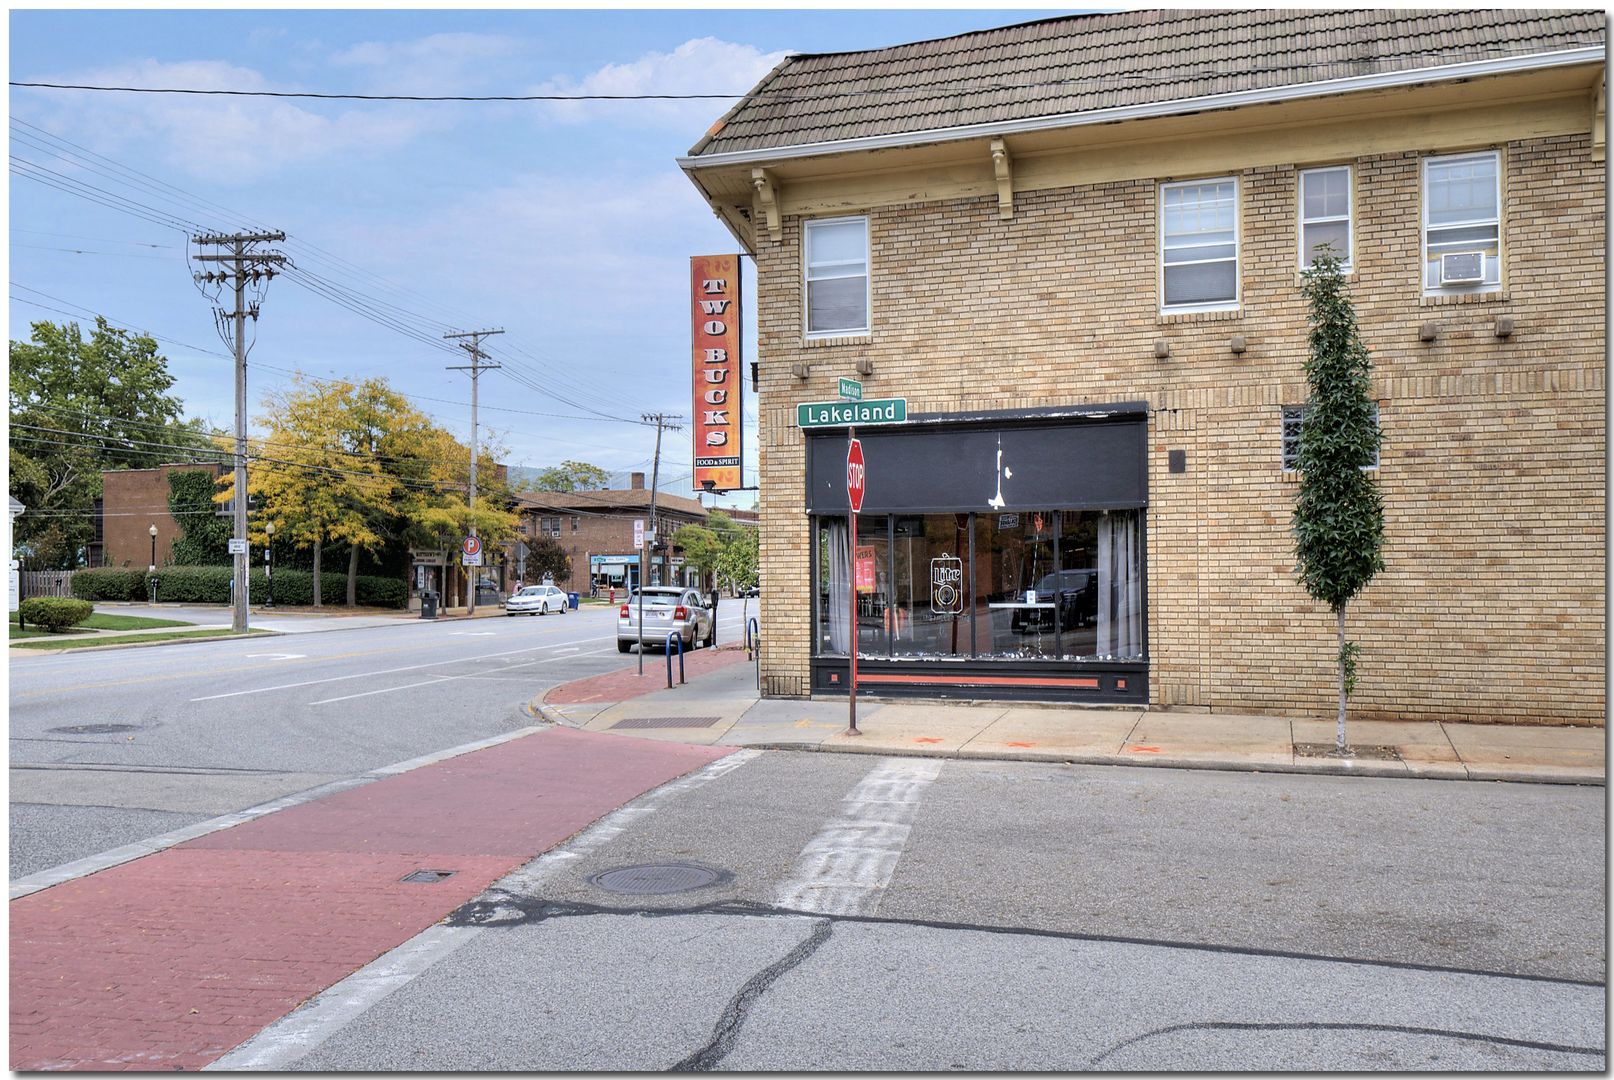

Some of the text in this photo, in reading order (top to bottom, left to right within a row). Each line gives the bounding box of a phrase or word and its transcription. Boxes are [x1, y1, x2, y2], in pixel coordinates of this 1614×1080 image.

[700, 279, 731, 448] TWO BUCKS
[841, 382, 860, 397] Madison
[808, 402, 895, 423] Lakeland
[848, 462, 864, 490] STOP
[468, 540, 475, 552] P
[856, 550, 872, 560] WERS
[933, 567, 961, 586] Lite
